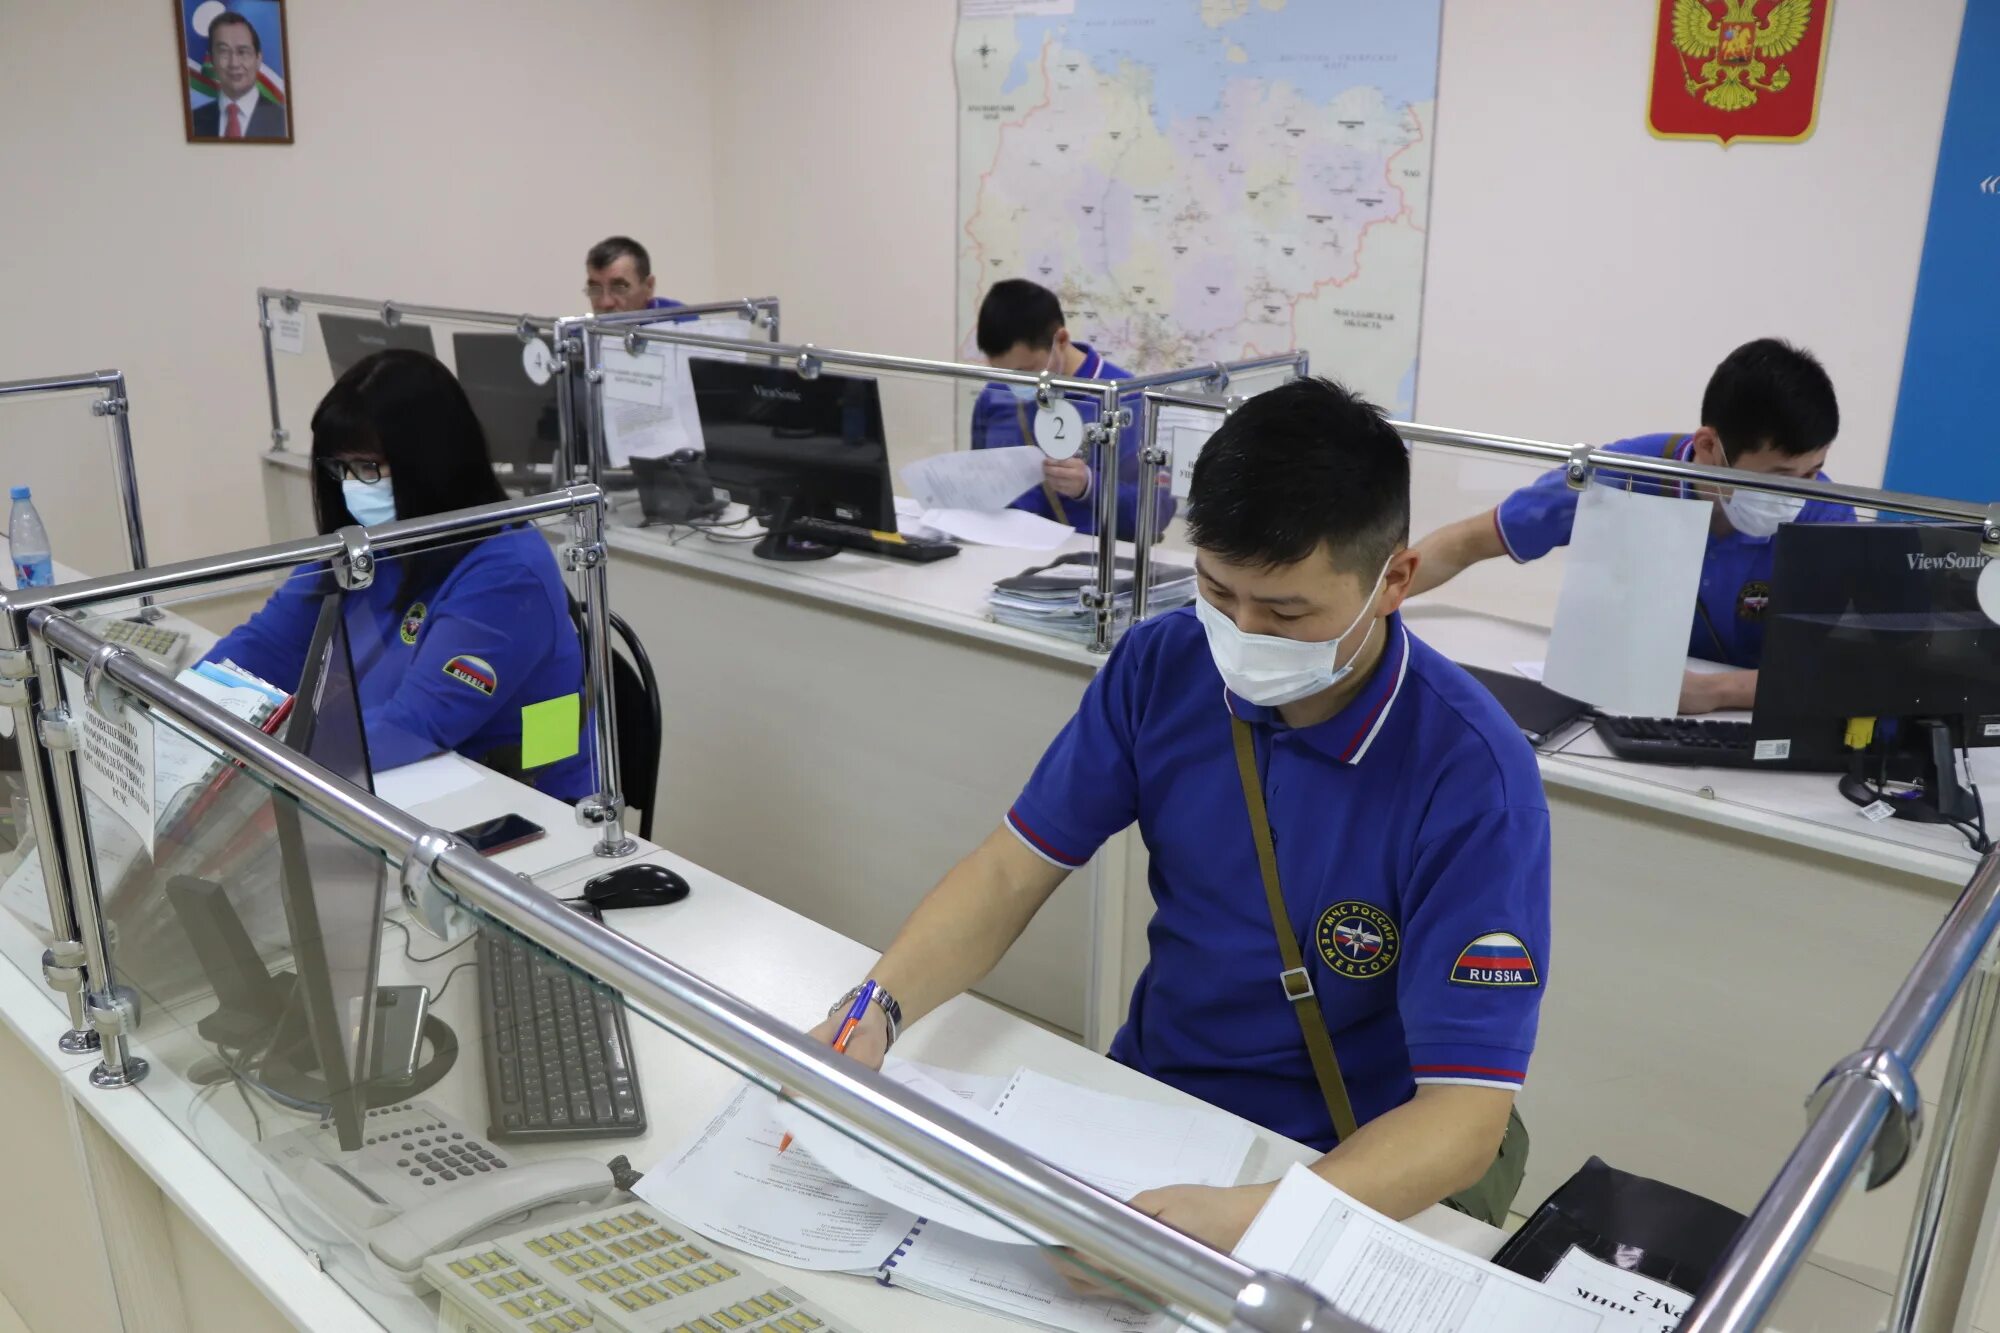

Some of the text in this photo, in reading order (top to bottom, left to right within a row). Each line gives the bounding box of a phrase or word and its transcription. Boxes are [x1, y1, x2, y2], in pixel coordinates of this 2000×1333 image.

[1053, 416, 1065, 440] 2
[1906, 552, 1990, 570] ViewSonic
[453, 668, 486, 689] RUSSIA
[1325, 905, 1395, 941] МЧС РОССИИ
[1321, 938, 1392, 974] EMERCOM
[1470, 968, 1523, 982] RUSSIA
